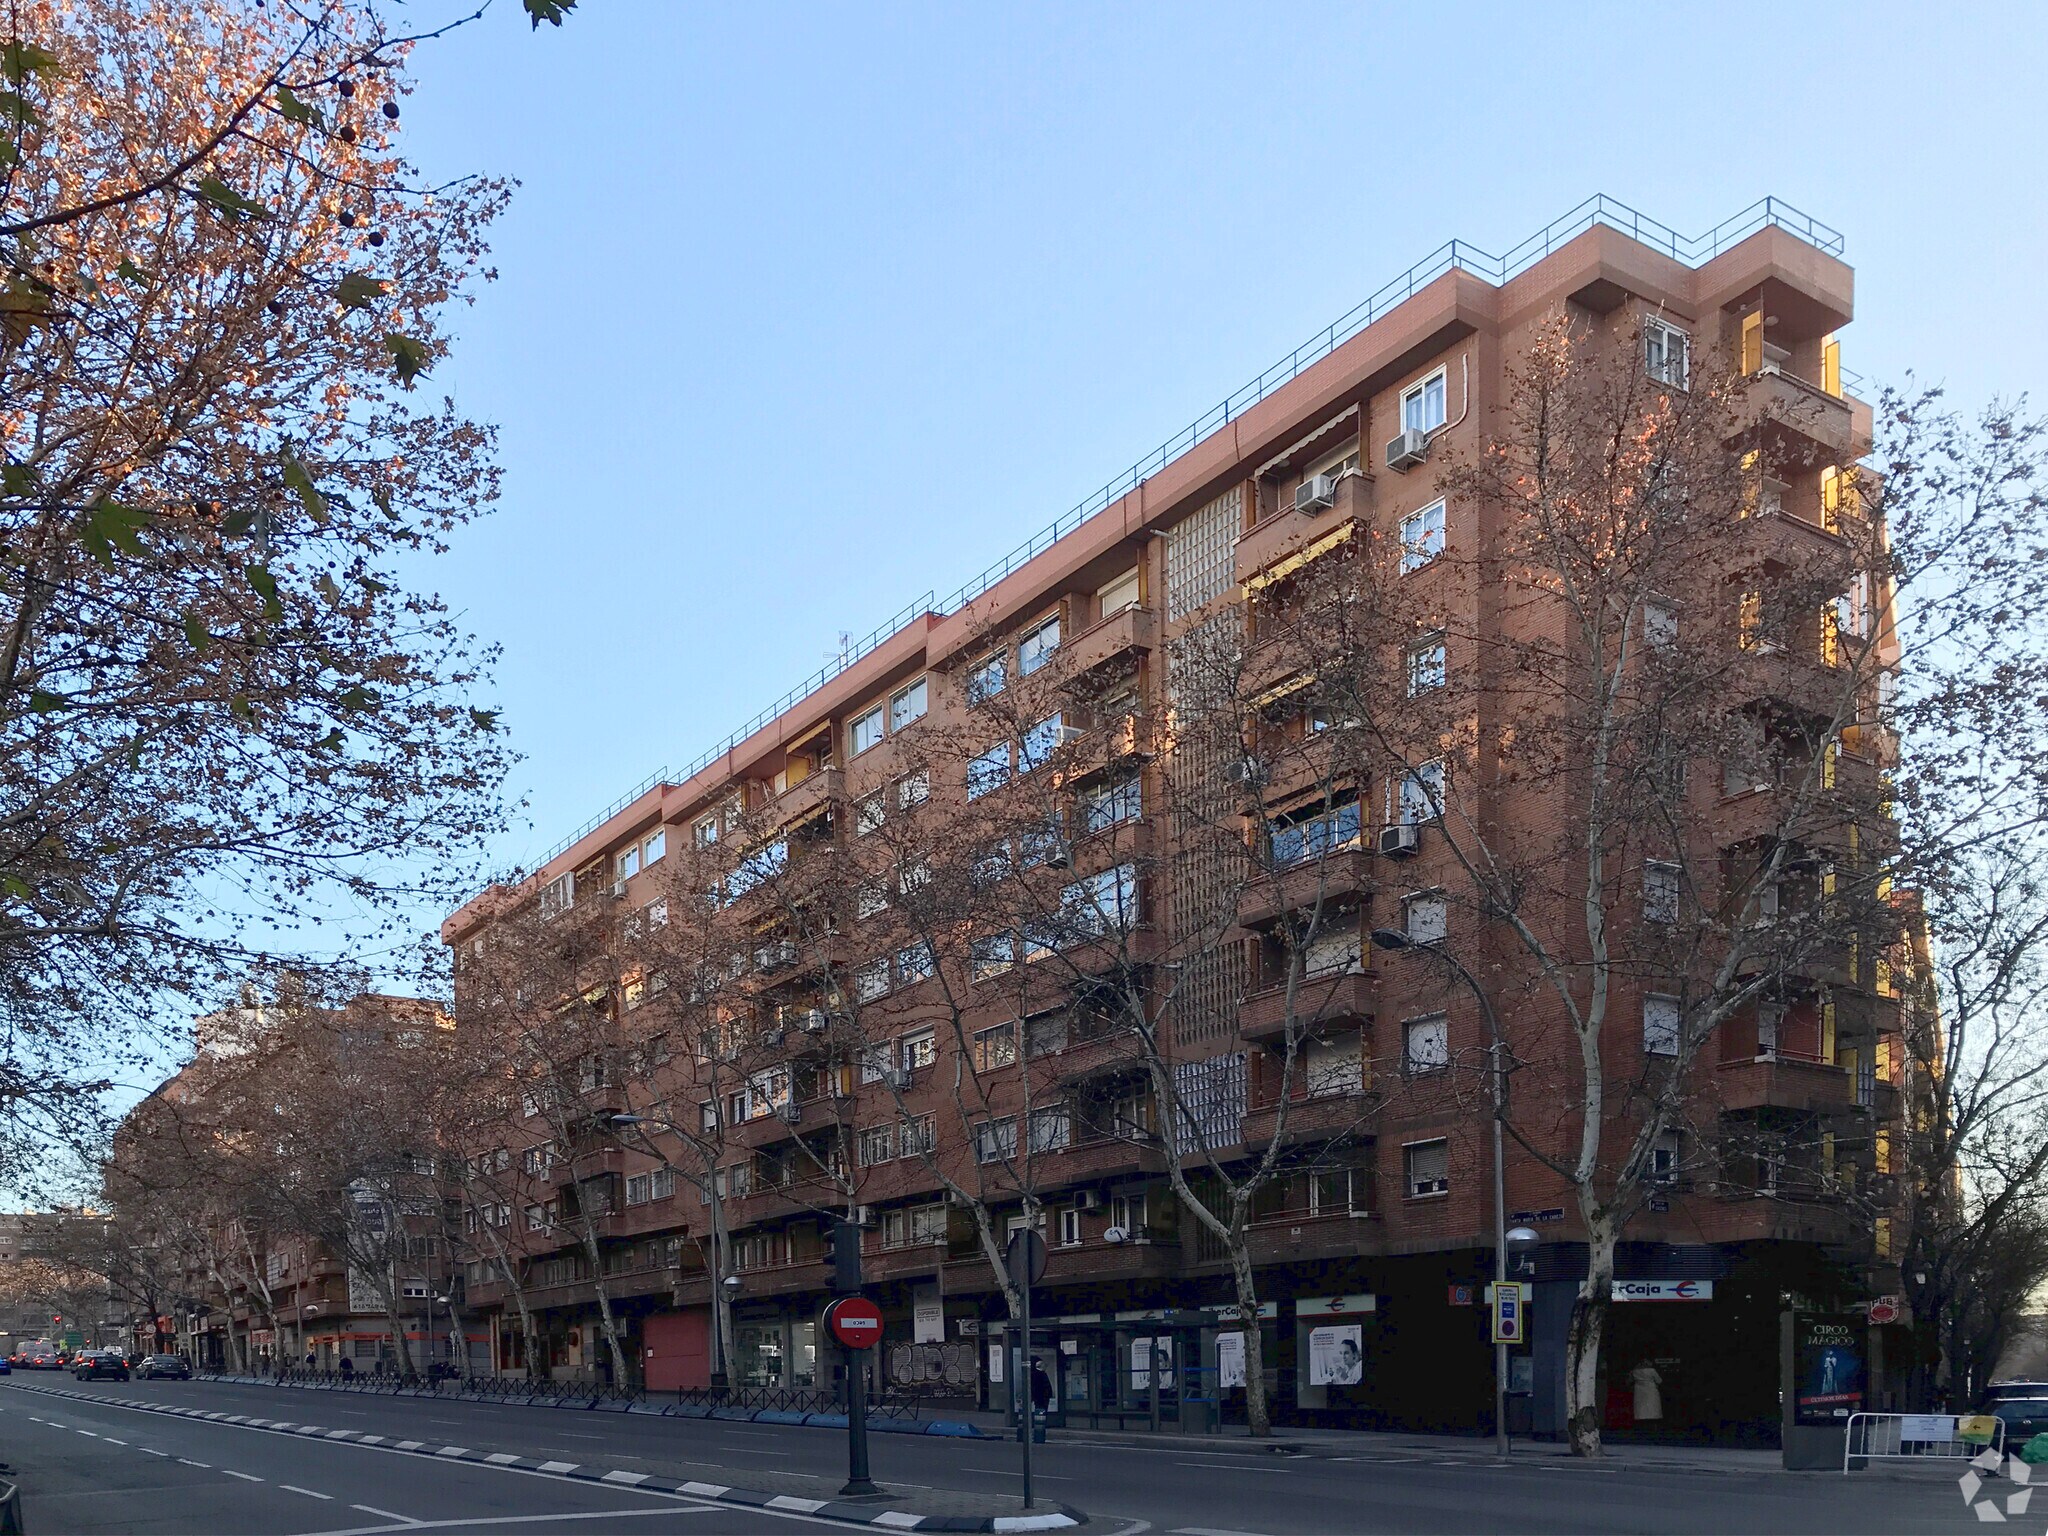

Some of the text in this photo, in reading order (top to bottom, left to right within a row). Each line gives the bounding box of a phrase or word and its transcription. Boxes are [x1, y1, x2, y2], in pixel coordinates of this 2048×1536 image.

[1611, 1283, 1661, 1296] erCaja
[1872, 1297, 1893, 1307] PUB
[1814, 1325, 1848, 1335] CIRCO
